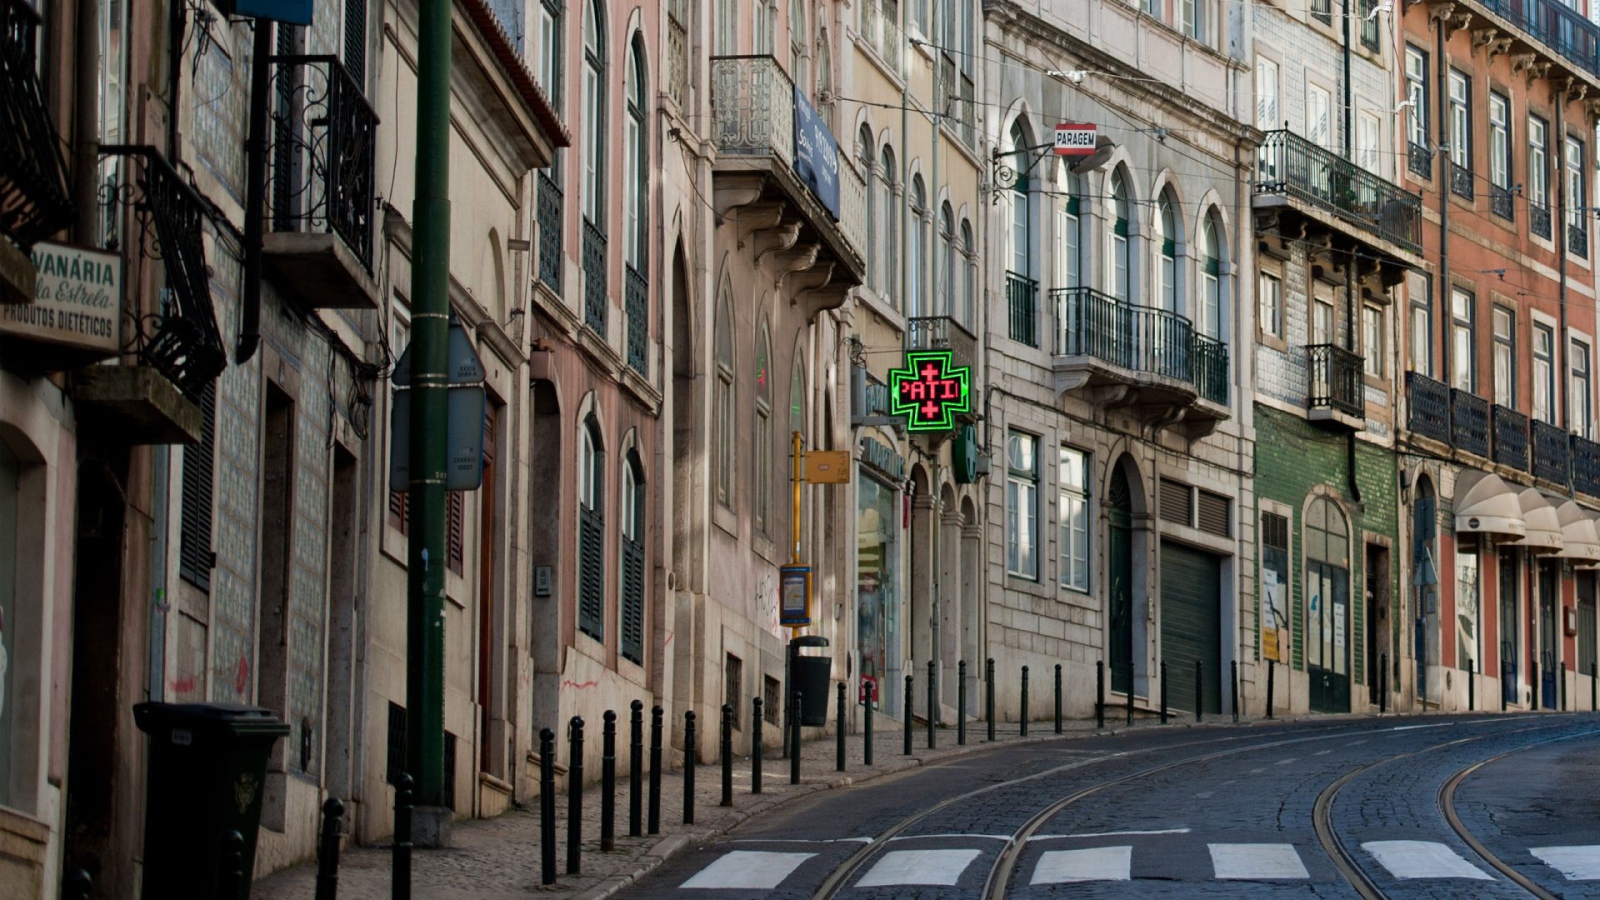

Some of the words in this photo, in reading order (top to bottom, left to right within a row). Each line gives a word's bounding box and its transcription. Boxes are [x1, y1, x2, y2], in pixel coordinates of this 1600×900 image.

[1056, 132, 1095, 145] PARAGEM
[55, 280, 113, 309] Estrela
[3, 303, 55, 328] PRODUTOS
[58, 309, 112, 339] DIETÉTICOS
